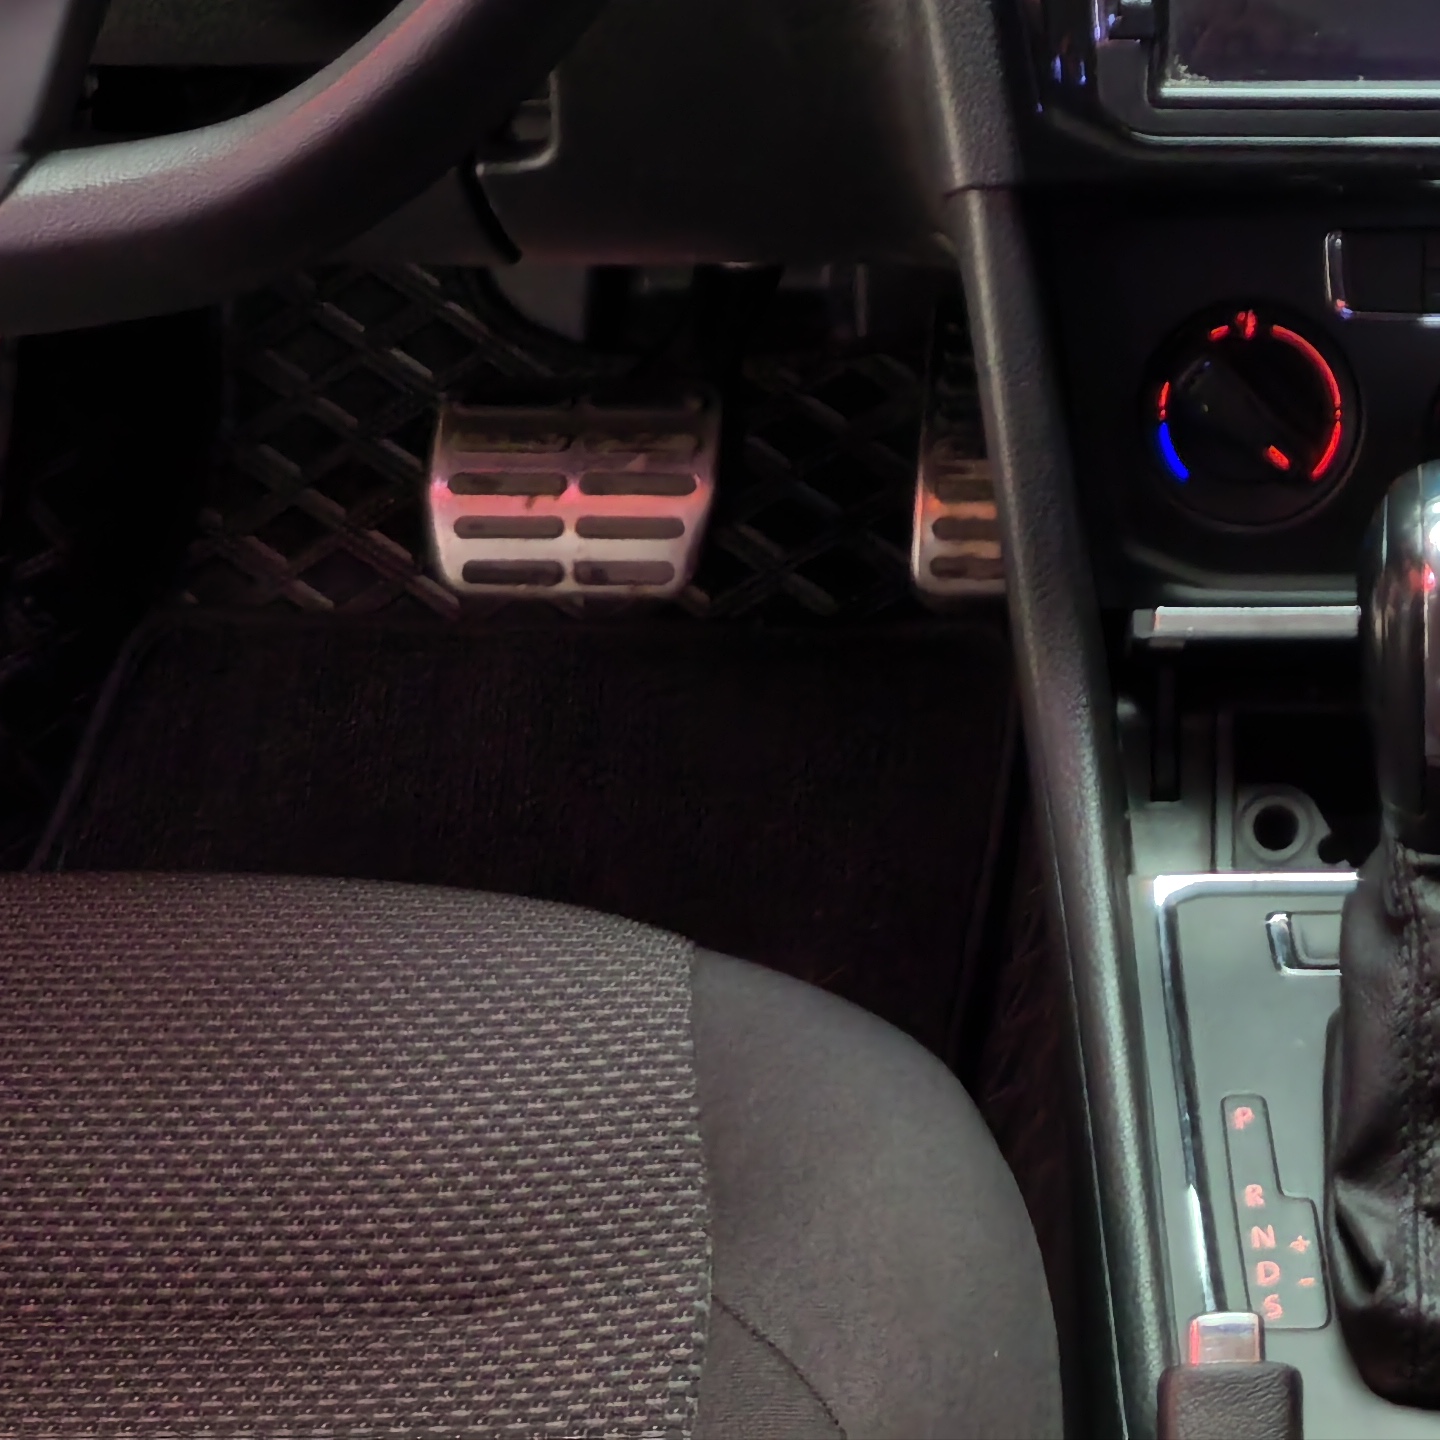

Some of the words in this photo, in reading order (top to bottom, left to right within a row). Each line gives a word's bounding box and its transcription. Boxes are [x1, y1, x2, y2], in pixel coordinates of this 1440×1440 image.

[1234, 1106, 1255, 1130] P
[1244, 1183, 1265, 1207] R
[1250, 1224, 1277, 1249] N
[1256, 1260, 1281, 1287] D
[1262, 1293, 1284, 1320] S
